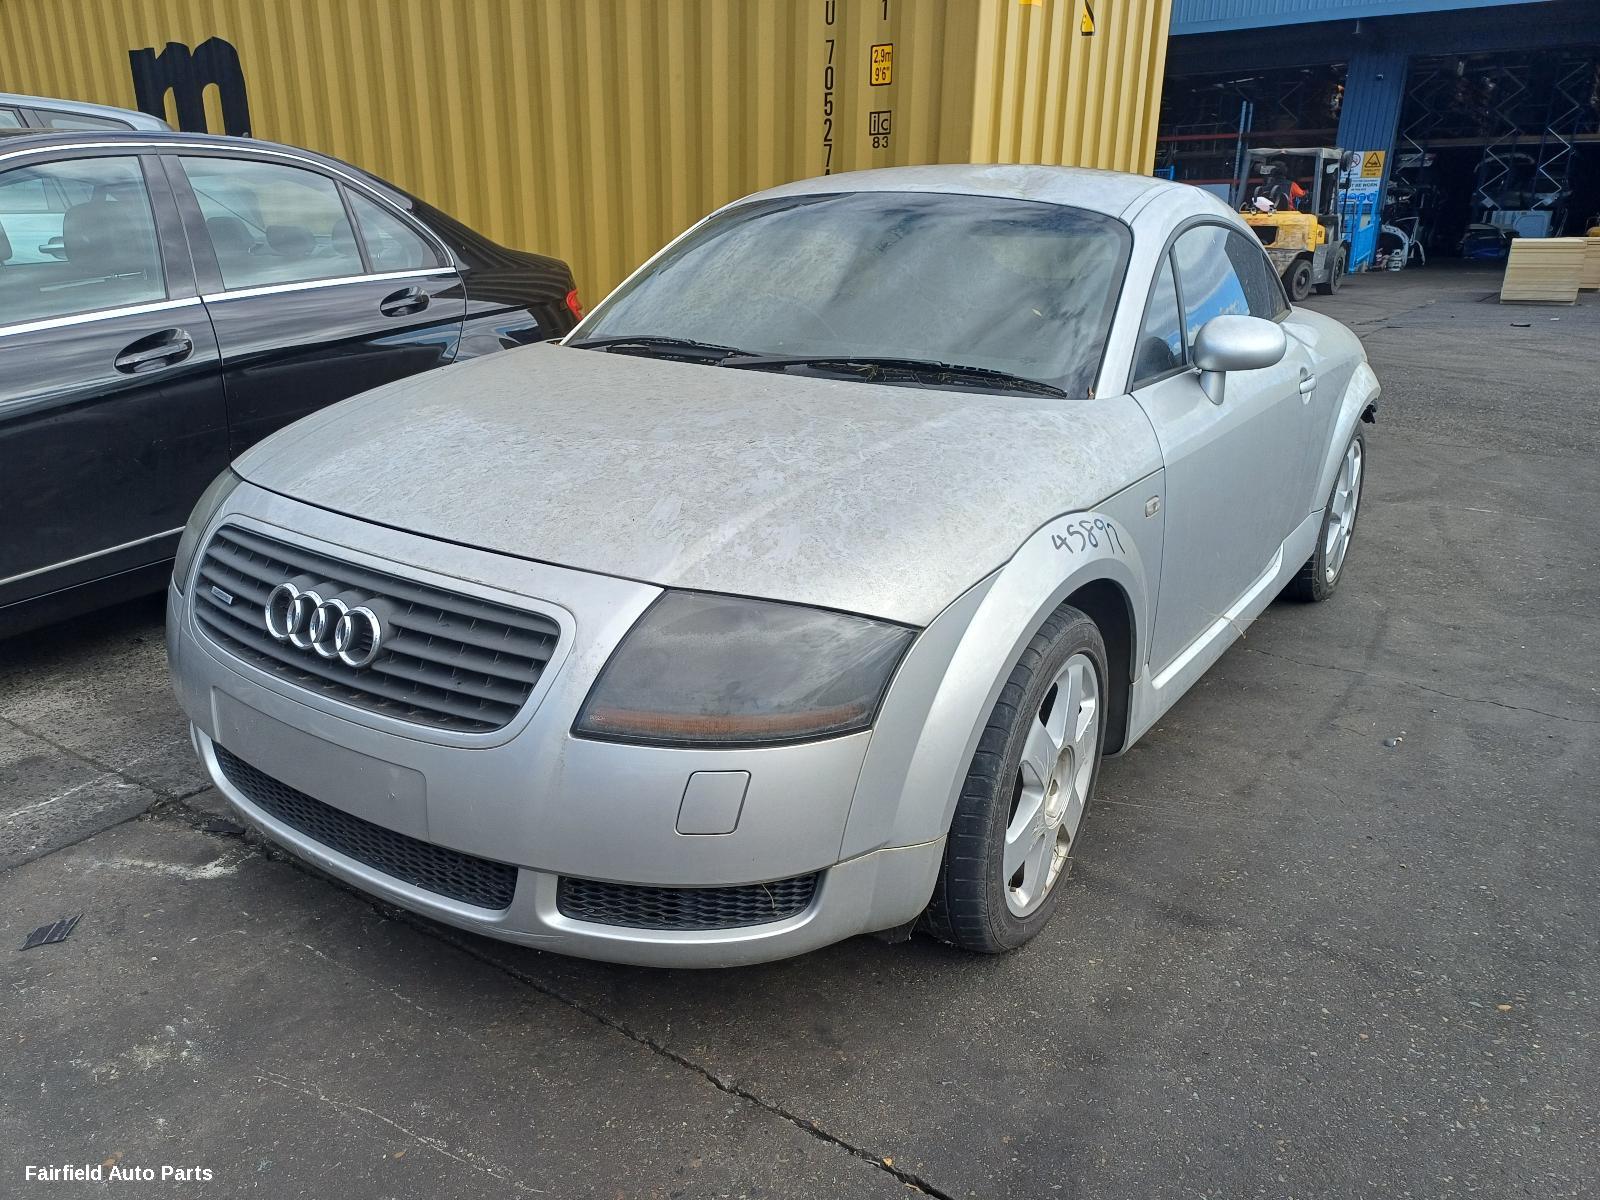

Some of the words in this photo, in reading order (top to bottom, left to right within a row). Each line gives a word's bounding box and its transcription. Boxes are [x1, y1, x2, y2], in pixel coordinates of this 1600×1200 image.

[824, 40, 835, 175] 70527
[872, 136, 889, 148] 83
[1051, 518, 1126, 554] 45897
